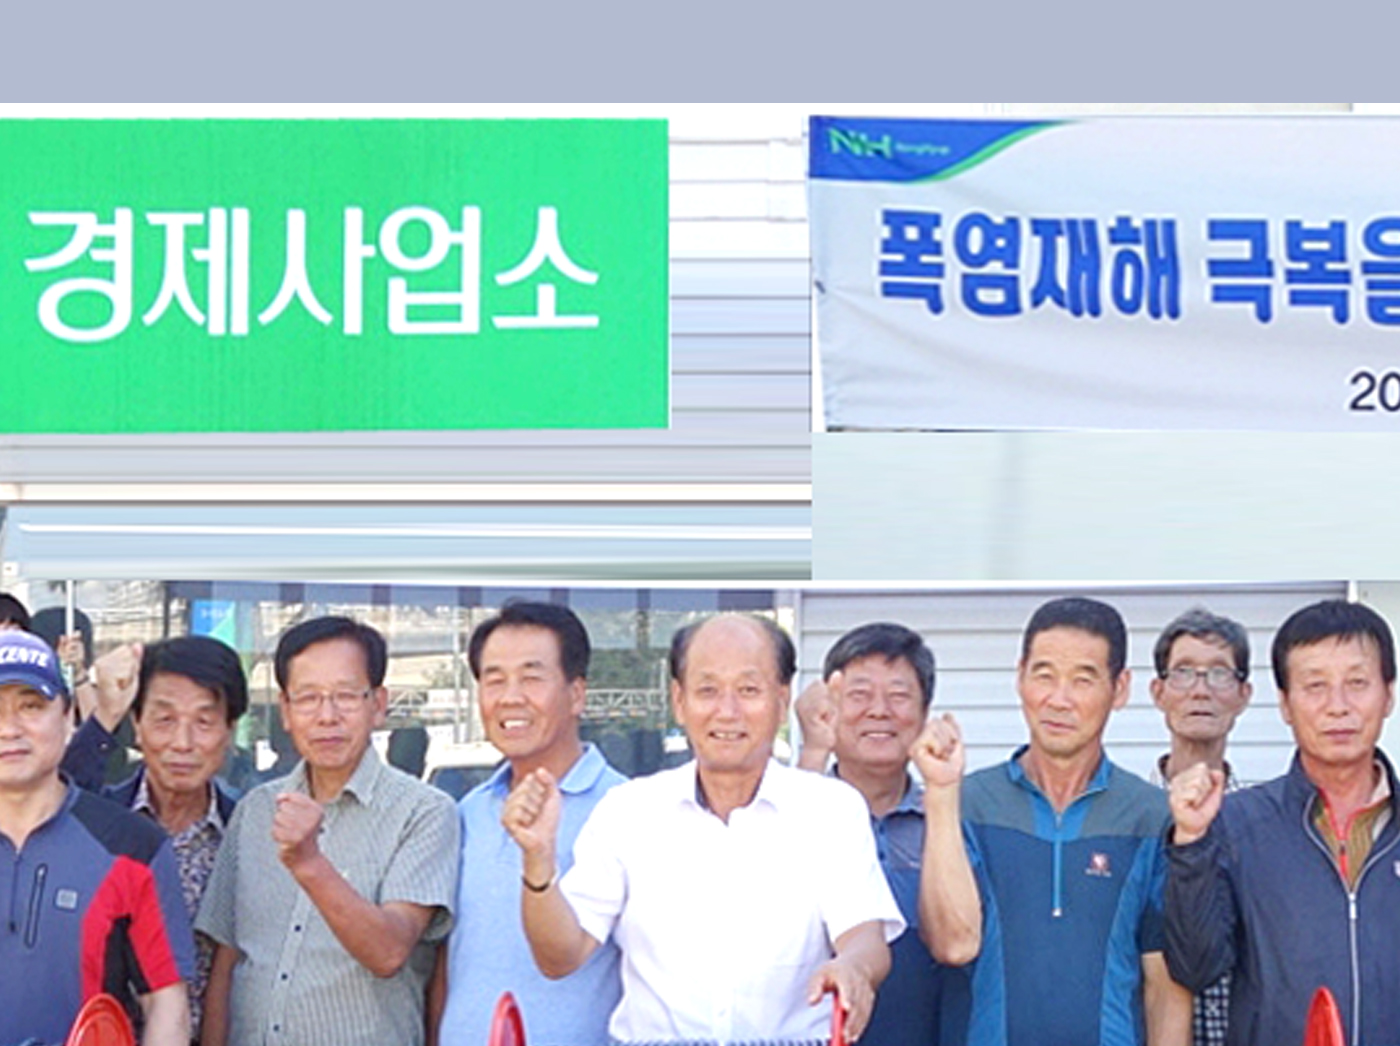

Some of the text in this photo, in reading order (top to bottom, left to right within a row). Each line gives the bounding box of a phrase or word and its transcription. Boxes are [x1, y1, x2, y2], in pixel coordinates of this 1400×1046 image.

[827, 127, 892, 159] NH
[24, 204, 600, 342] 경제사업소
[879, 209, 1182, 320] 폭염재해
